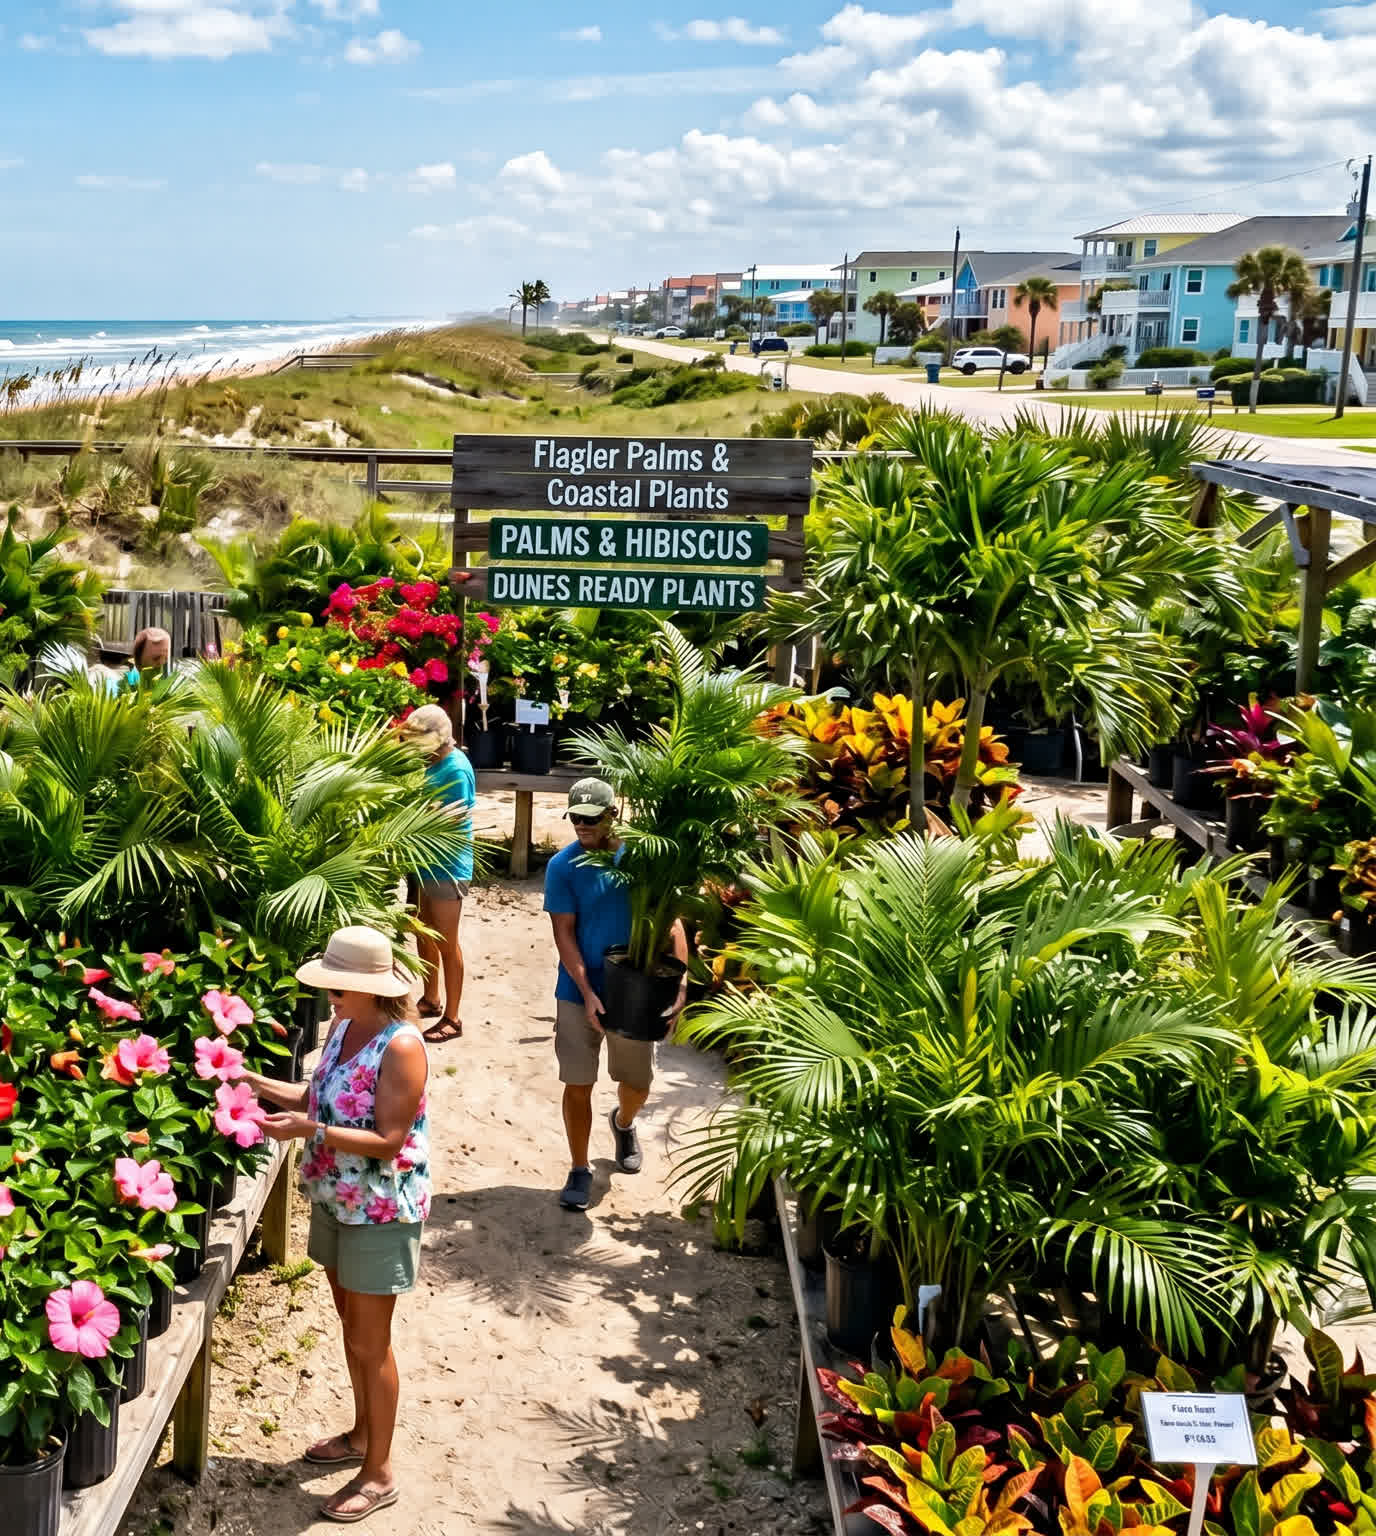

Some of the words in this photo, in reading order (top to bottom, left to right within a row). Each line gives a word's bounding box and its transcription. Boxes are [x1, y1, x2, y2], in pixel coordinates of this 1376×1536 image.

[533, 439, 620, 476] Flagler
[627, 441, 703, 472] Palms
[711, 442, 730, 473] &
[546, 478, 640, 508] Coastal
[649, 479, 730, 510] Plants
[501, 524, 591, 556] PALMS
[598, 526, 617, 557] &
[625, 527, 753, 561] HIBISCUS
[493, 572, 571, 601] DUNES
[579, 574, 656, 604] READY
[662, 577, 756, 608] PLANTS
